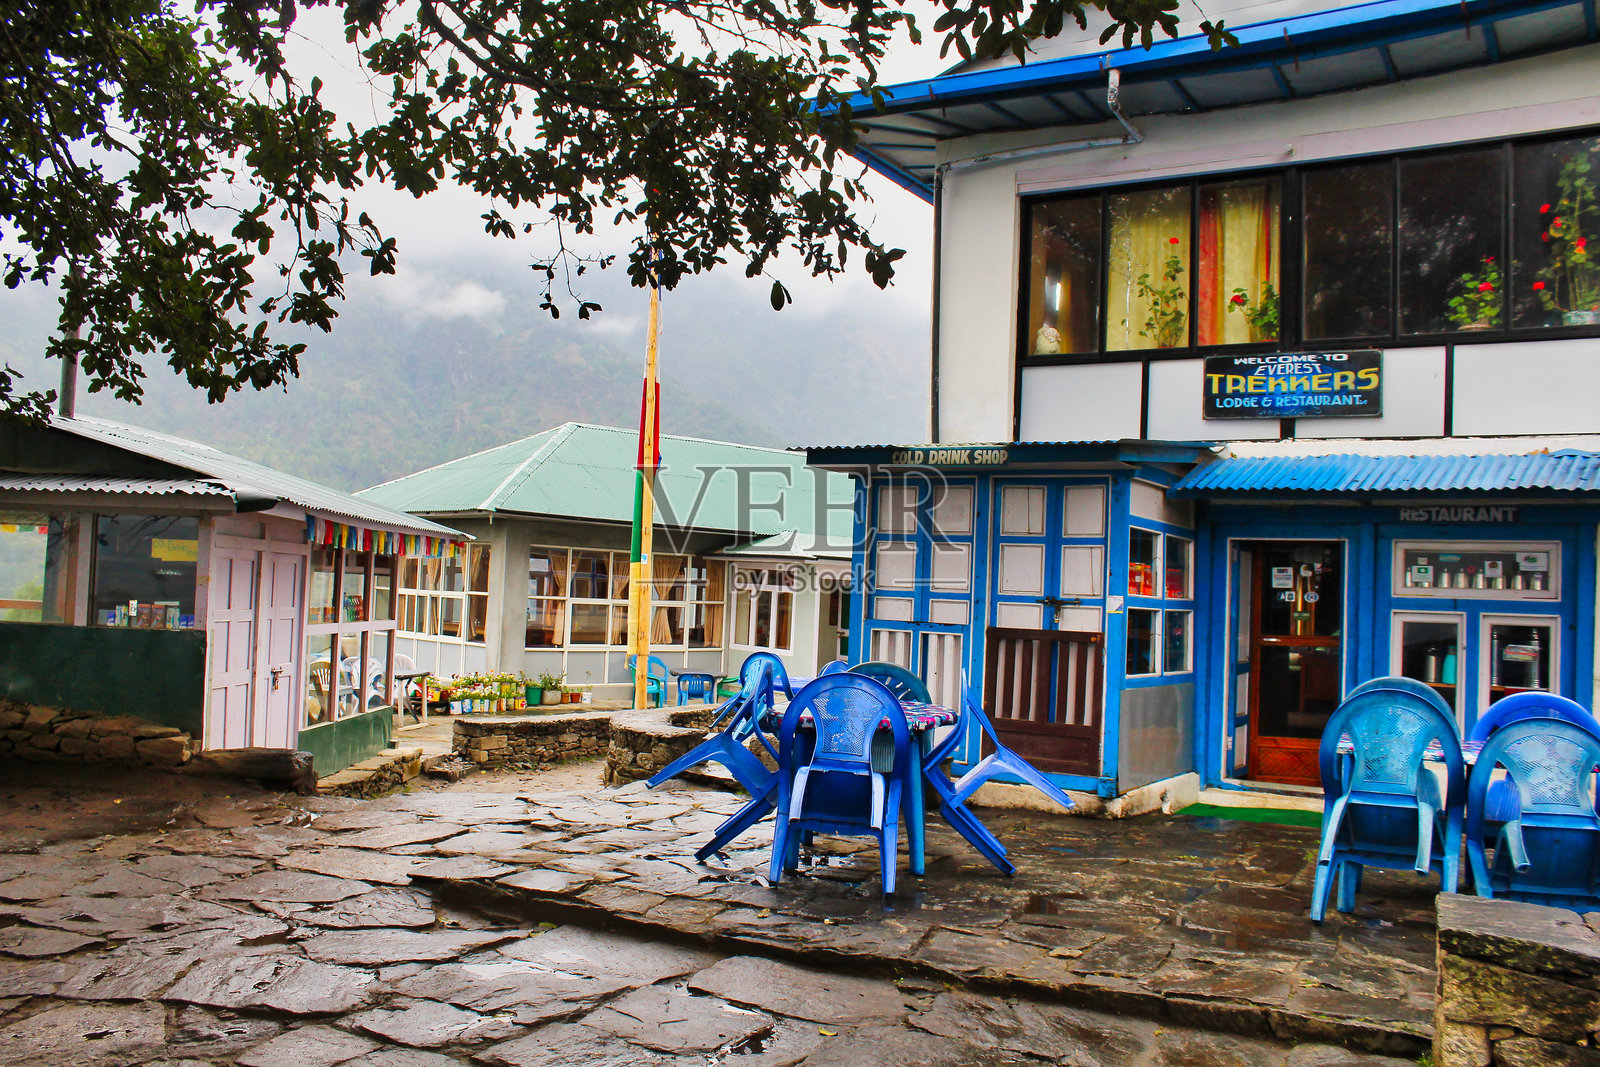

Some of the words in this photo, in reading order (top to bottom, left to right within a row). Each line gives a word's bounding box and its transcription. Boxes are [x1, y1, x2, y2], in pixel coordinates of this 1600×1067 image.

[1254, 363, 1322, 376] EVEREST
[1206, 367, 1380, 395] TREKKERS
[1215, 397, 1259, 408] LODGE
[1261, 399, 1273, 407] &
[892, 450, 924, 464] COLD
[928, 449, 971, 465] DRINK
[973, 449, 1009, 464] SHOP
[1400, 506, 1519, 522] RESTAURANT
